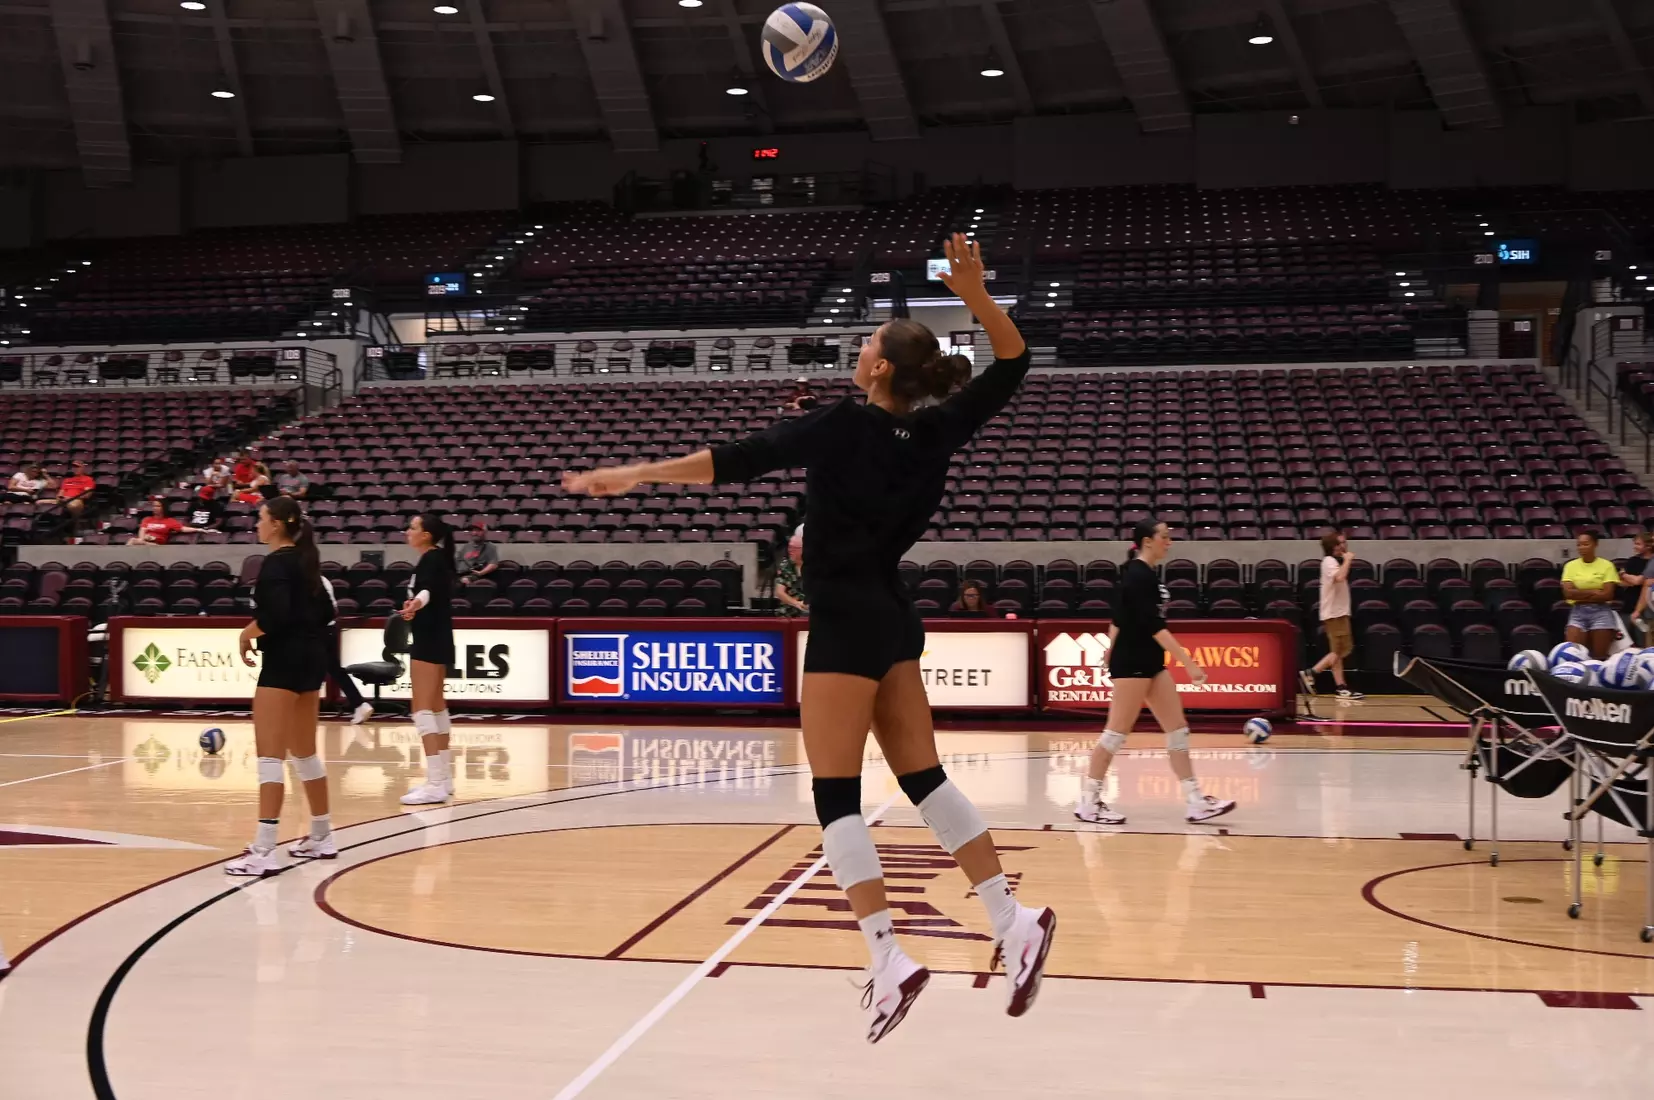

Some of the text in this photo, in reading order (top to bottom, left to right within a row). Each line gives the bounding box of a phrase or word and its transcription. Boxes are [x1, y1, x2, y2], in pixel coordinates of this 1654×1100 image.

[1508, 250, 1530, 260] SIH
[176, 648, 234, 667] FARM
[572, 651, 619, 659] SHELTER
[632, 642, 776, 670] SHELTER
[198, 669, 258, 682] ILLIN
[632, 672, 776, 693] INSURANCE
[921, 669, 992, 686] TREET
[443, 684, 502, 693] OLUTIONS
[1047, 690, 1114, 702] RENTALS
[1565, 697, 1632, 724] molten
